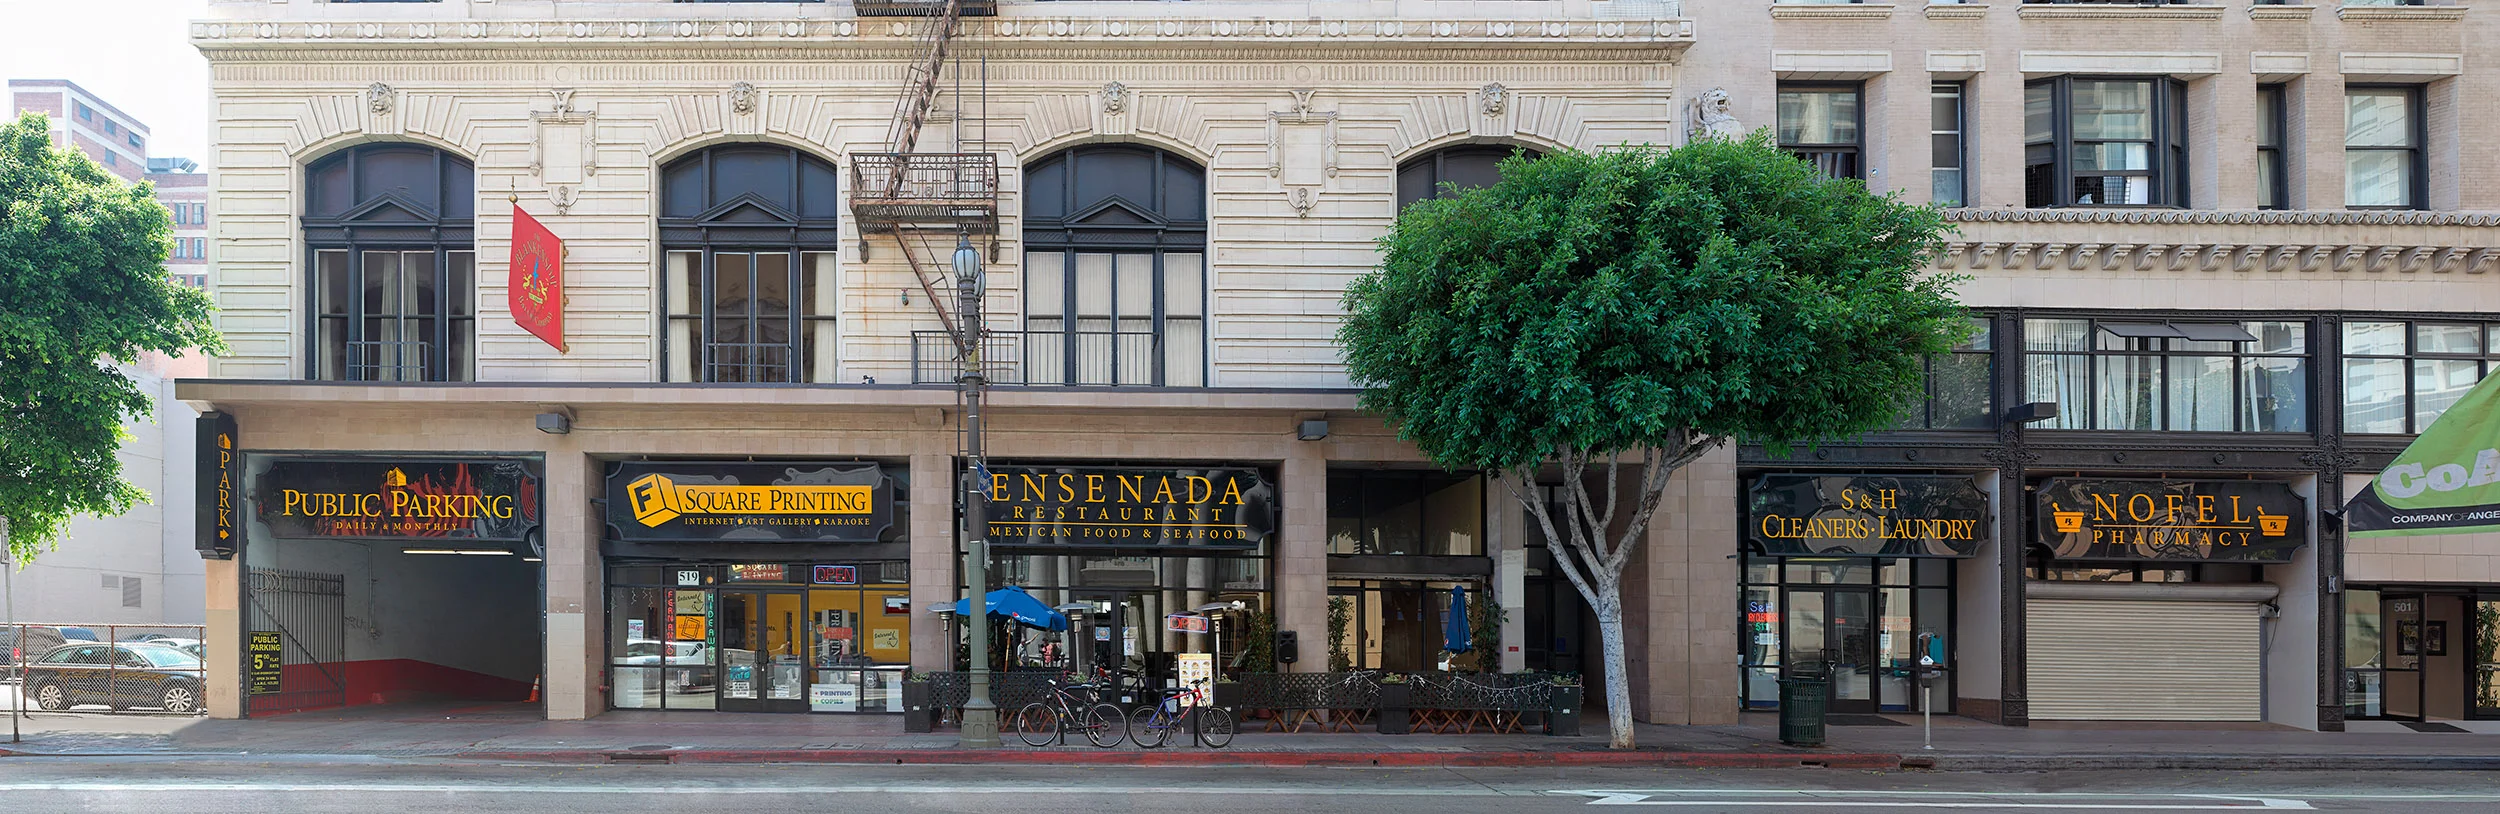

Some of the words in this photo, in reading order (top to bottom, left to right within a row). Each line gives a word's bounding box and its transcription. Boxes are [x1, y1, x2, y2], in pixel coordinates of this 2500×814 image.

[219, 451, 231, 528] PARK
[634, 481, 653, 513] F
[991, 473, 1246, 505] ENSENADA
[283, 489, 382, 518] PUBLIC
[390, 490, 514, 519] PARKING
[685, 488, 762, 514] SQUARE
[769, 489, 867, 511] PRINTING
[1841, 488, 1854, 510] S
[1860, 494, 1873, 510] &
[1879, 489, 1897, 510] H
[1013, 505, 1223, 522] RESTAURANT
[2091, 493, 2251, 523] NOFEL
[336, 521, 378, 531] DAILY
[382, 522, 390, 531] &
[393, 522, 459, 532] MONTHLY
[684, 517, 735, 526] INTERNET
[745, 518, 765, 526] ART
[768, 518, 812, 527] GALLERY
[823, 518, 871, 527] KARAOKE
[1762, 514, 1870, 540] CLEANERS
[1878, 515, 1977, 541] LAUNDRY
[989, 526, 1073, 538] MEXICAN
[1084, 528, 1132, 539] FOOD
[1142, 529, 1152, 539] &
[1163, 529, 1247, 540] SEAFOOD
[2092, 530, 2251, 547] PHARMACY
[679, 571, 698, 582] 519
[816, 567, 854, 582] OPEN
[1750, 601, 1774, 612] S&H
[707, 593, 716, 663] HIDEAWAY
[1169, 617, 1207, 631] OPEN
[254, 653, 264, 670] 5
